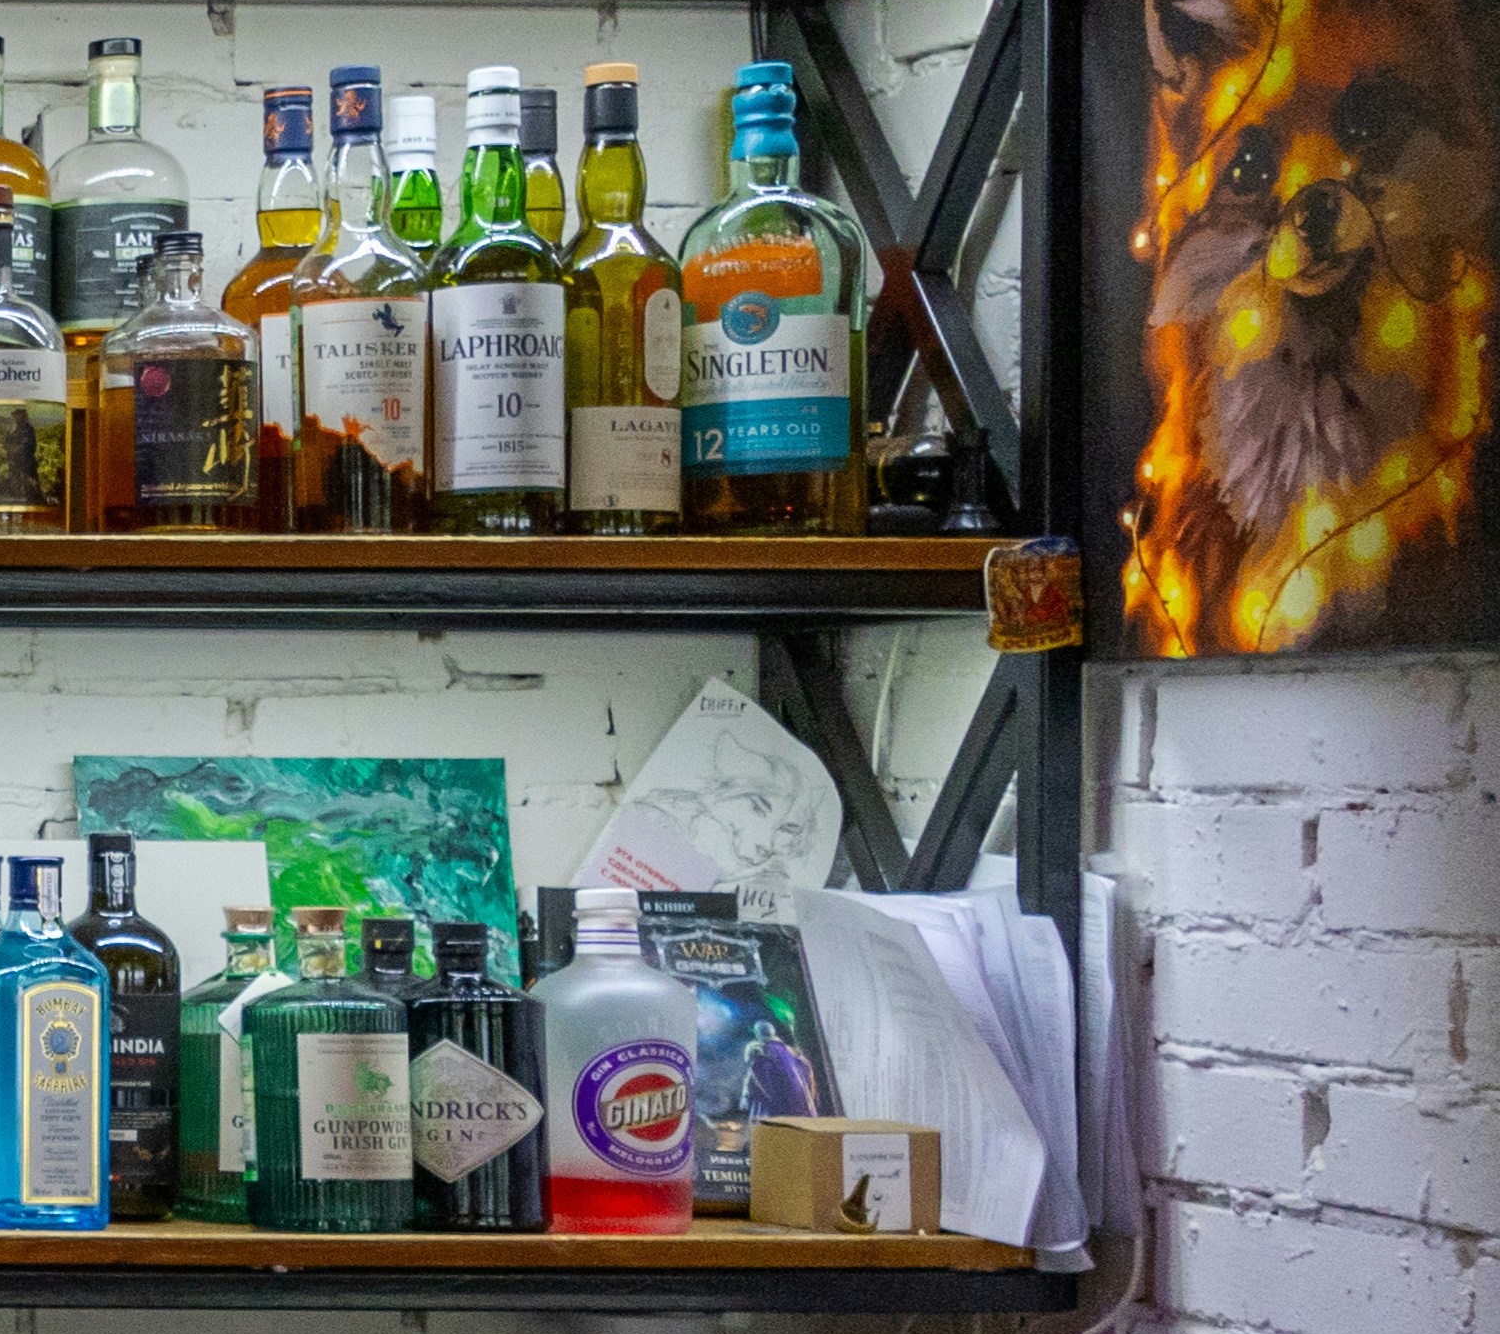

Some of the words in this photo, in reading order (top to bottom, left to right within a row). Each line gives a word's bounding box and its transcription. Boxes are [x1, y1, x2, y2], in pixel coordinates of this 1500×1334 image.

[314, 342, 418, 360] TALISKER
[686, 347, 828, 384] SINGLETON
[381, 398, 401, 421] 10
[495, 393, 522, 421] 10
[498, 440, 525, 454] 1815
[693, 429, 724, 461] 12
[728, 423, 783, 439] YEARS
[787, 422, 821, 436] OLD
[680, 942, 728, 960] WAR
[36, 996, 85, 1017] BOMBAY
[114, 1040, 165, 1054] INDIA
[35, 1073, 89, 1094] SAPPHIRE
[607, 1085, 686, 1129] GINATO
[333, 1137, 383, 1149] IRISH
[388, 1138, 408, 1149] GIN
[427, 1130, 474, 1142] GIN
